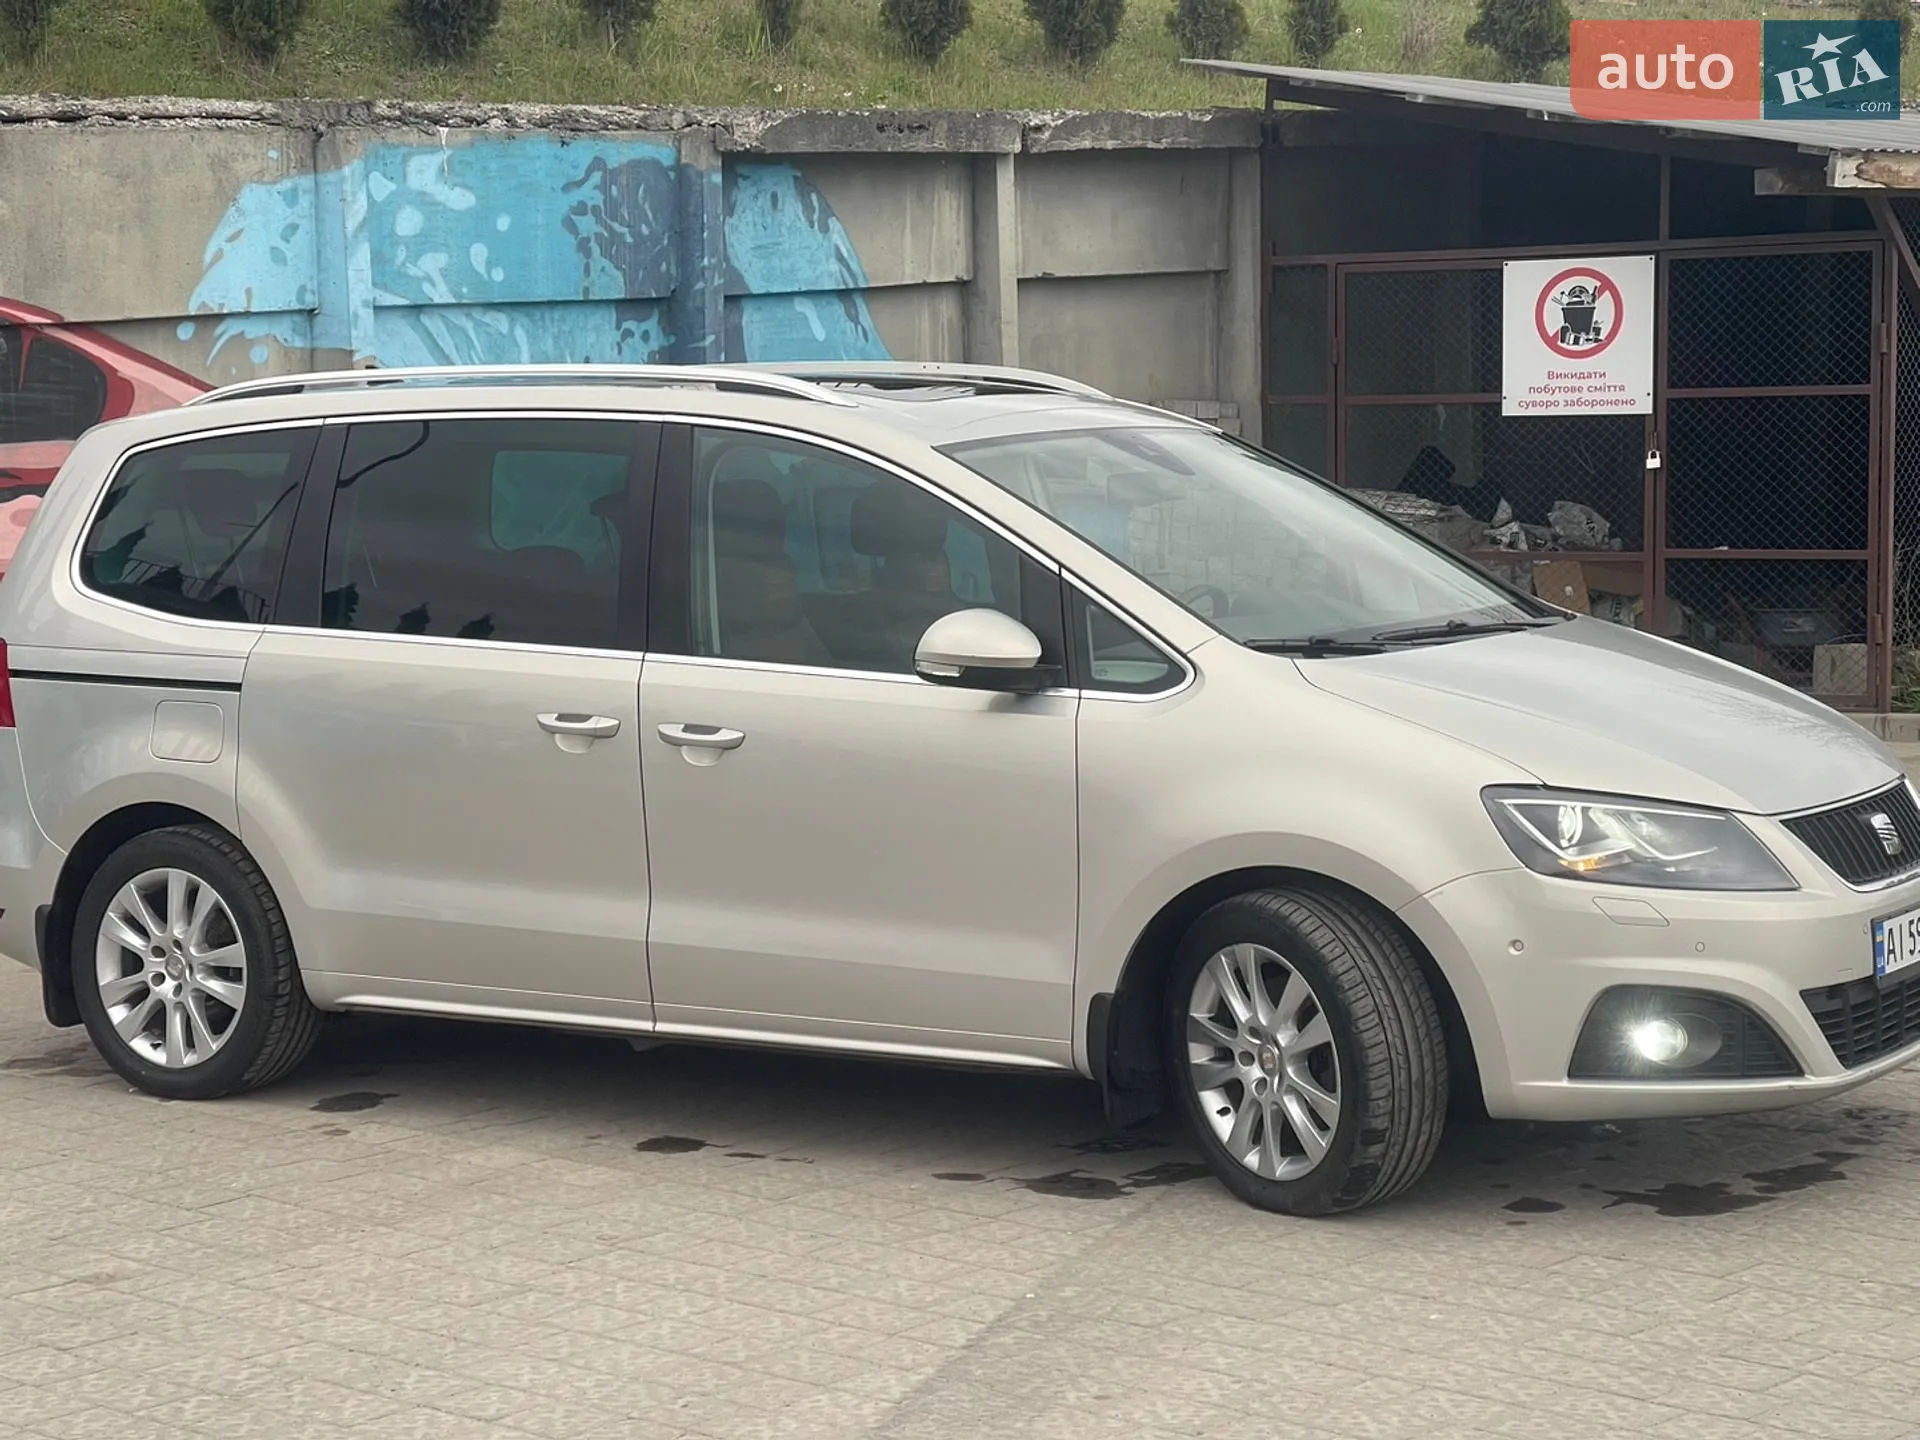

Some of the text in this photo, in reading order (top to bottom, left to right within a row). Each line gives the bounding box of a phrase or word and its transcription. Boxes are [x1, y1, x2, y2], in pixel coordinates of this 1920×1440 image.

[1547, 370, 1606, 380] Викидати
[1528, 382, 1626, 396] побутове сміття
[1518, 396, 1637, 409] суворо заборонено
